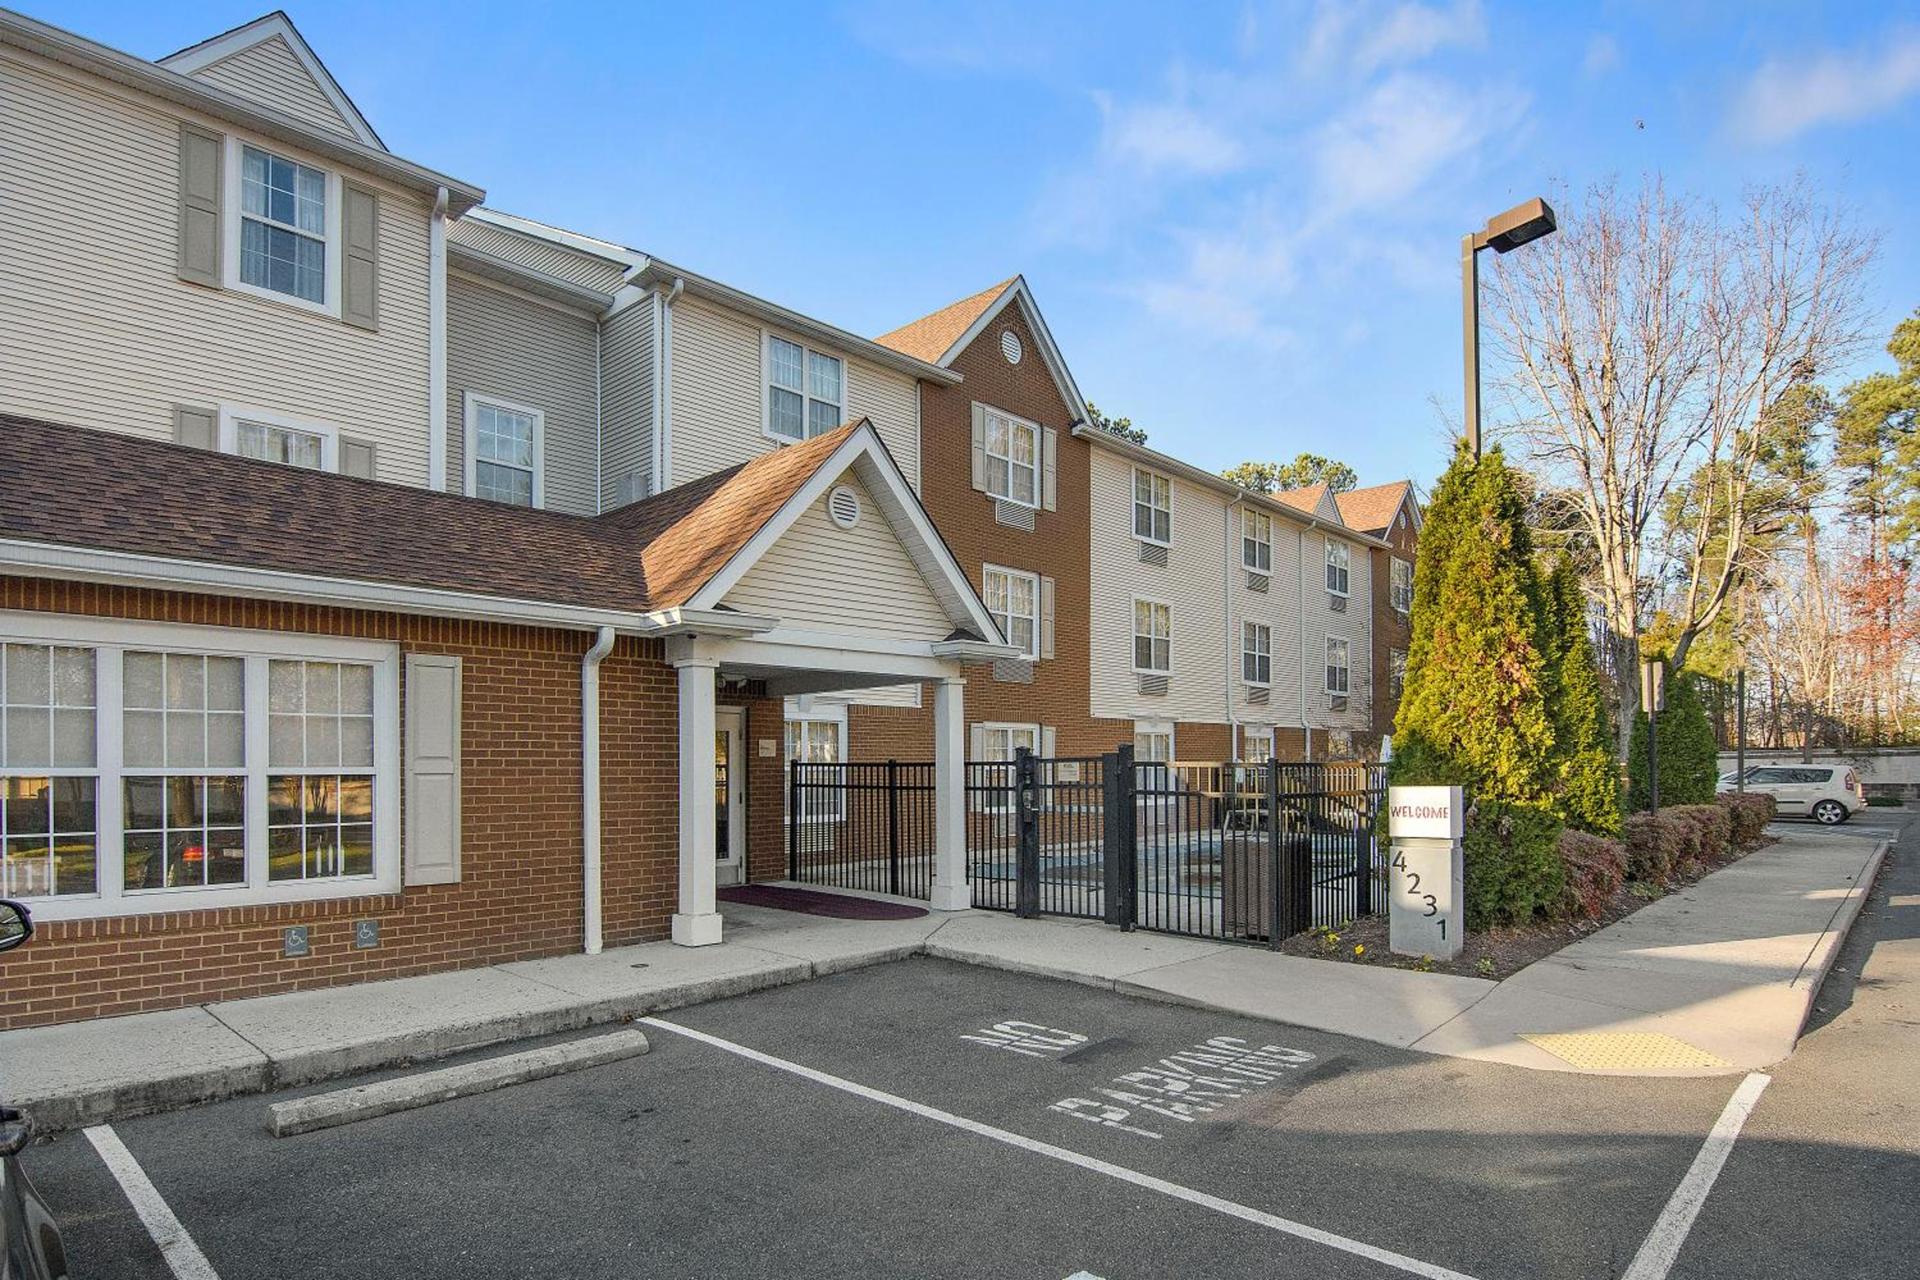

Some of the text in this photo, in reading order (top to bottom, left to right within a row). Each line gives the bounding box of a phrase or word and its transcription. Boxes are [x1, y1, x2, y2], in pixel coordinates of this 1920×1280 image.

[1390, 805, 1449, 819] WELCOME
[959, 1020, 1089, 1058] NO
[1046, 1035, 1317, 1139] PARKING
